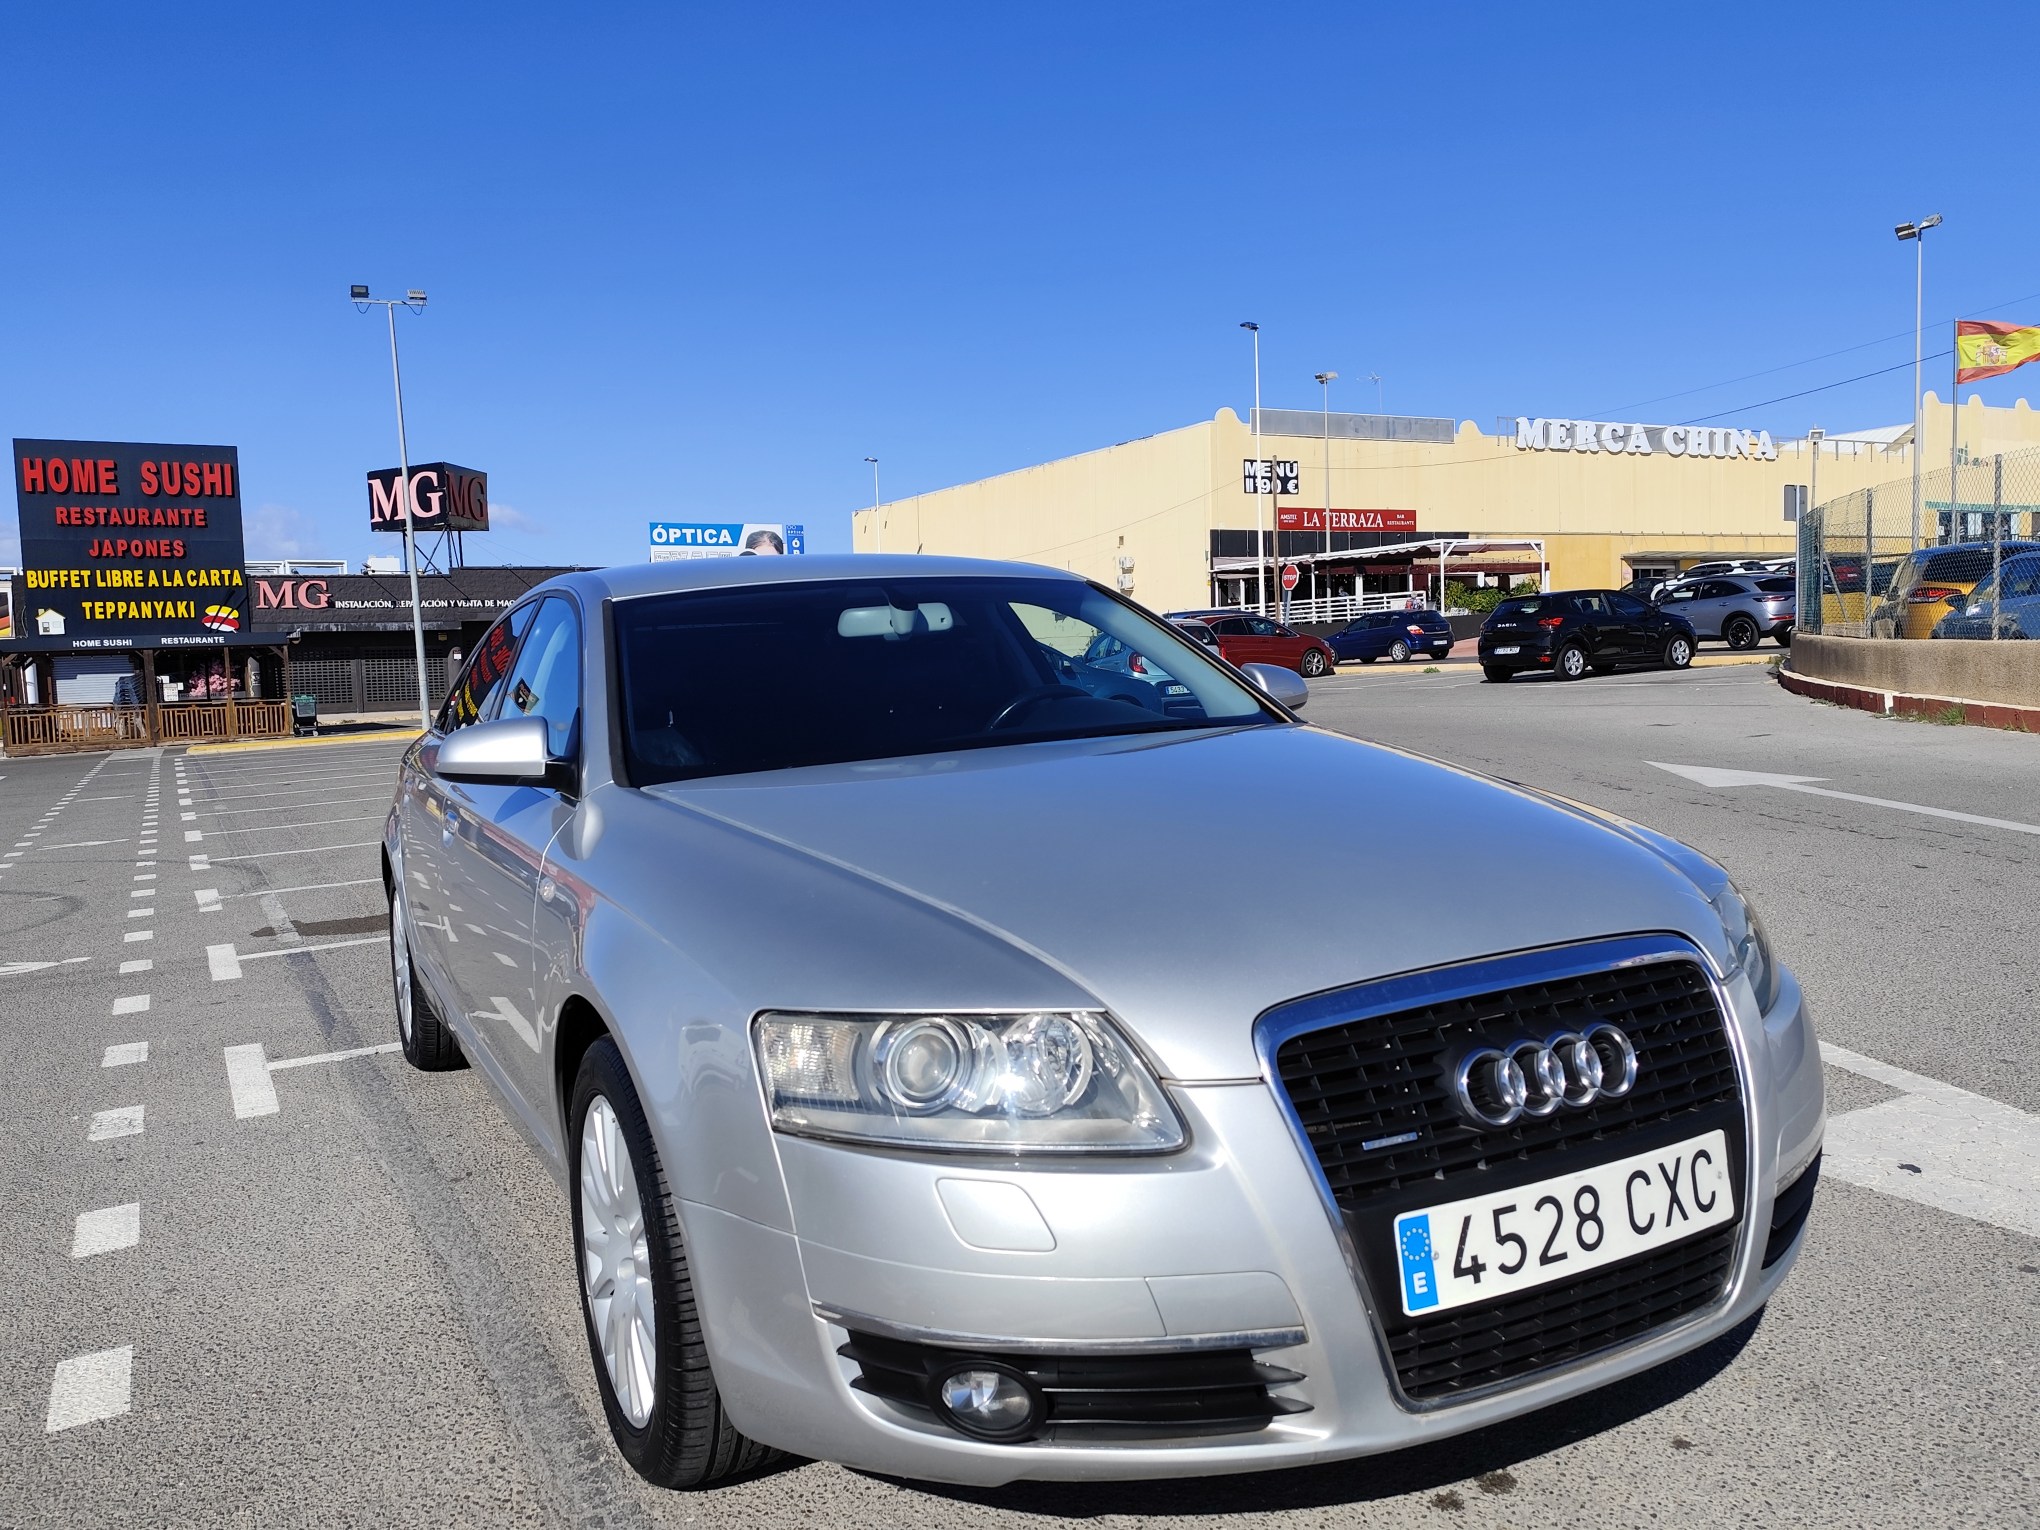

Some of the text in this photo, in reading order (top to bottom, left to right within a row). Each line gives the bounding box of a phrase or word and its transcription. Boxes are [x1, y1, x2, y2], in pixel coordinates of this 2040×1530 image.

[1516, 417, 1778, 461] MERCA CHINA
[22, 457, 234, 497] HOME SUSHI
[1286, 479, 1299, 494] €
[367, 470, 444, 523] MG
[55, 506, 207, 526] RESTAURANTE
[1303, 511, 1384, 528] LA TERRAZA
[652, 525, 733, 544] ÓPTICA
[89, 539, 186, 558] JAPONES
[26, 569, 244, 589] BUFFET LIBRE A LA CARTA
[255, 579, 333, 610] MG
[395, 598, 448, 608] REPAACIÓN
[450, 600, 456, 608] Y
[456, 600, 483, 608] VENTA
[484, 600, 495, 608] DE
[81, 600, 196, 620] TEPPANYAKI
[72, 639, 133, 648] HOME SUSHI
[160, 636, 226, 645] RESTAURANTE
[1413, 1148, 1717, 1295] E 4528 CXC
